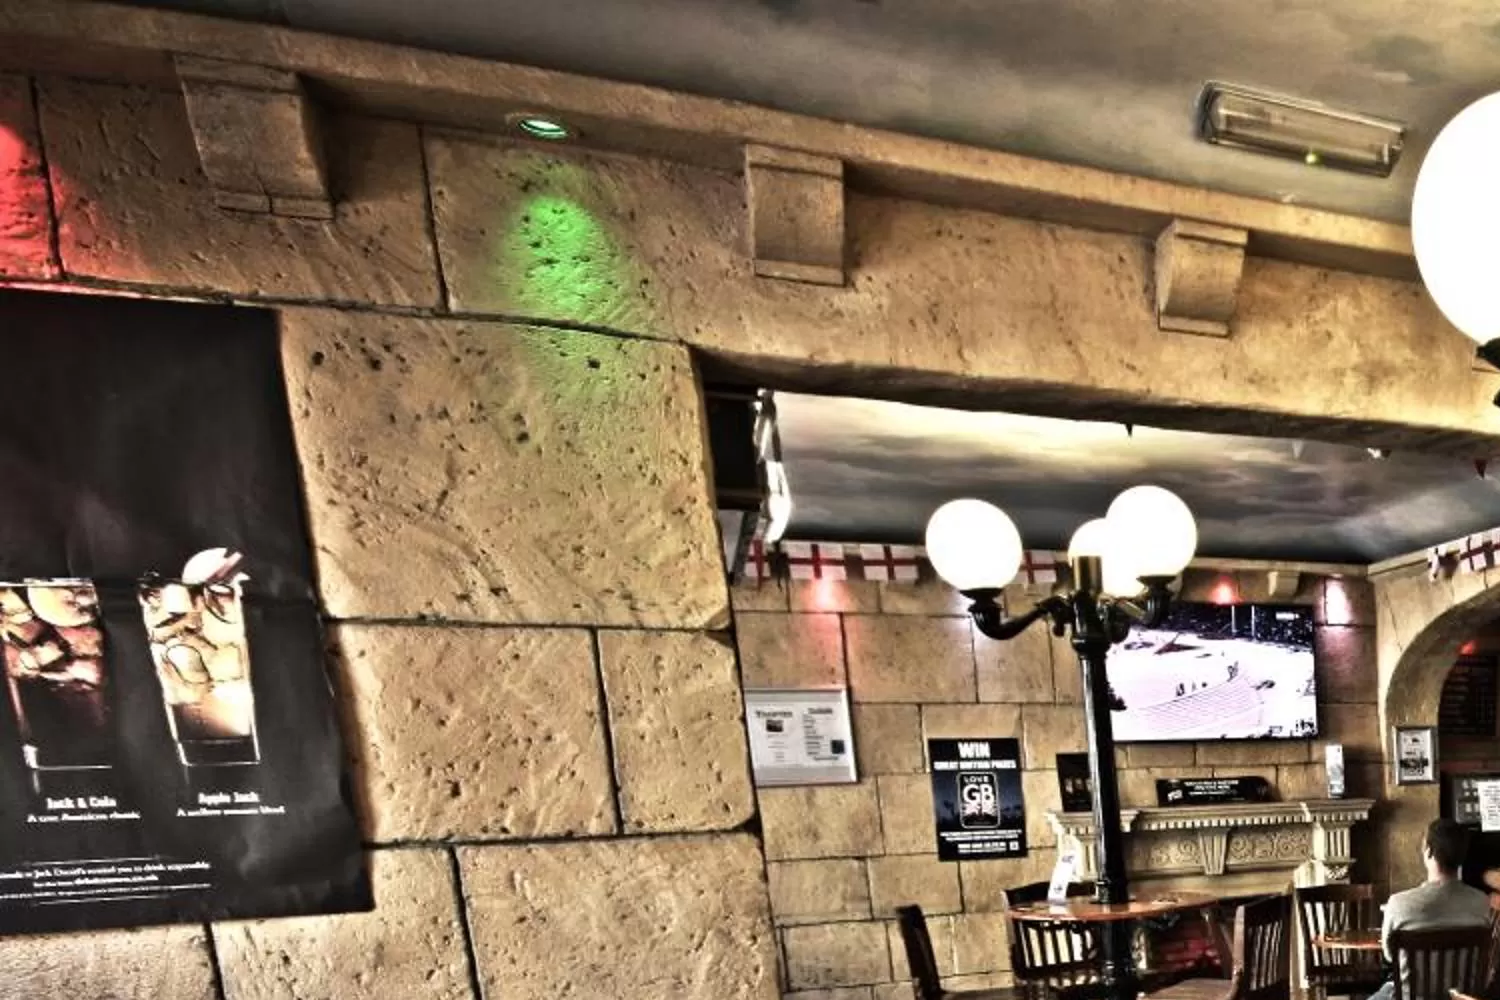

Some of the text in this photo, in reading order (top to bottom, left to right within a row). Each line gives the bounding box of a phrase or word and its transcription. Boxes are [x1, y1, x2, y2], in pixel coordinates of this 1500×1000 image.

[957, 741, 992, 759] WIN
[963, 775, 989, 783] LOVE
[962, 783, 995, 808] GB
[176, 806, 187, 817] A
[26, 813, 37, 823] A
